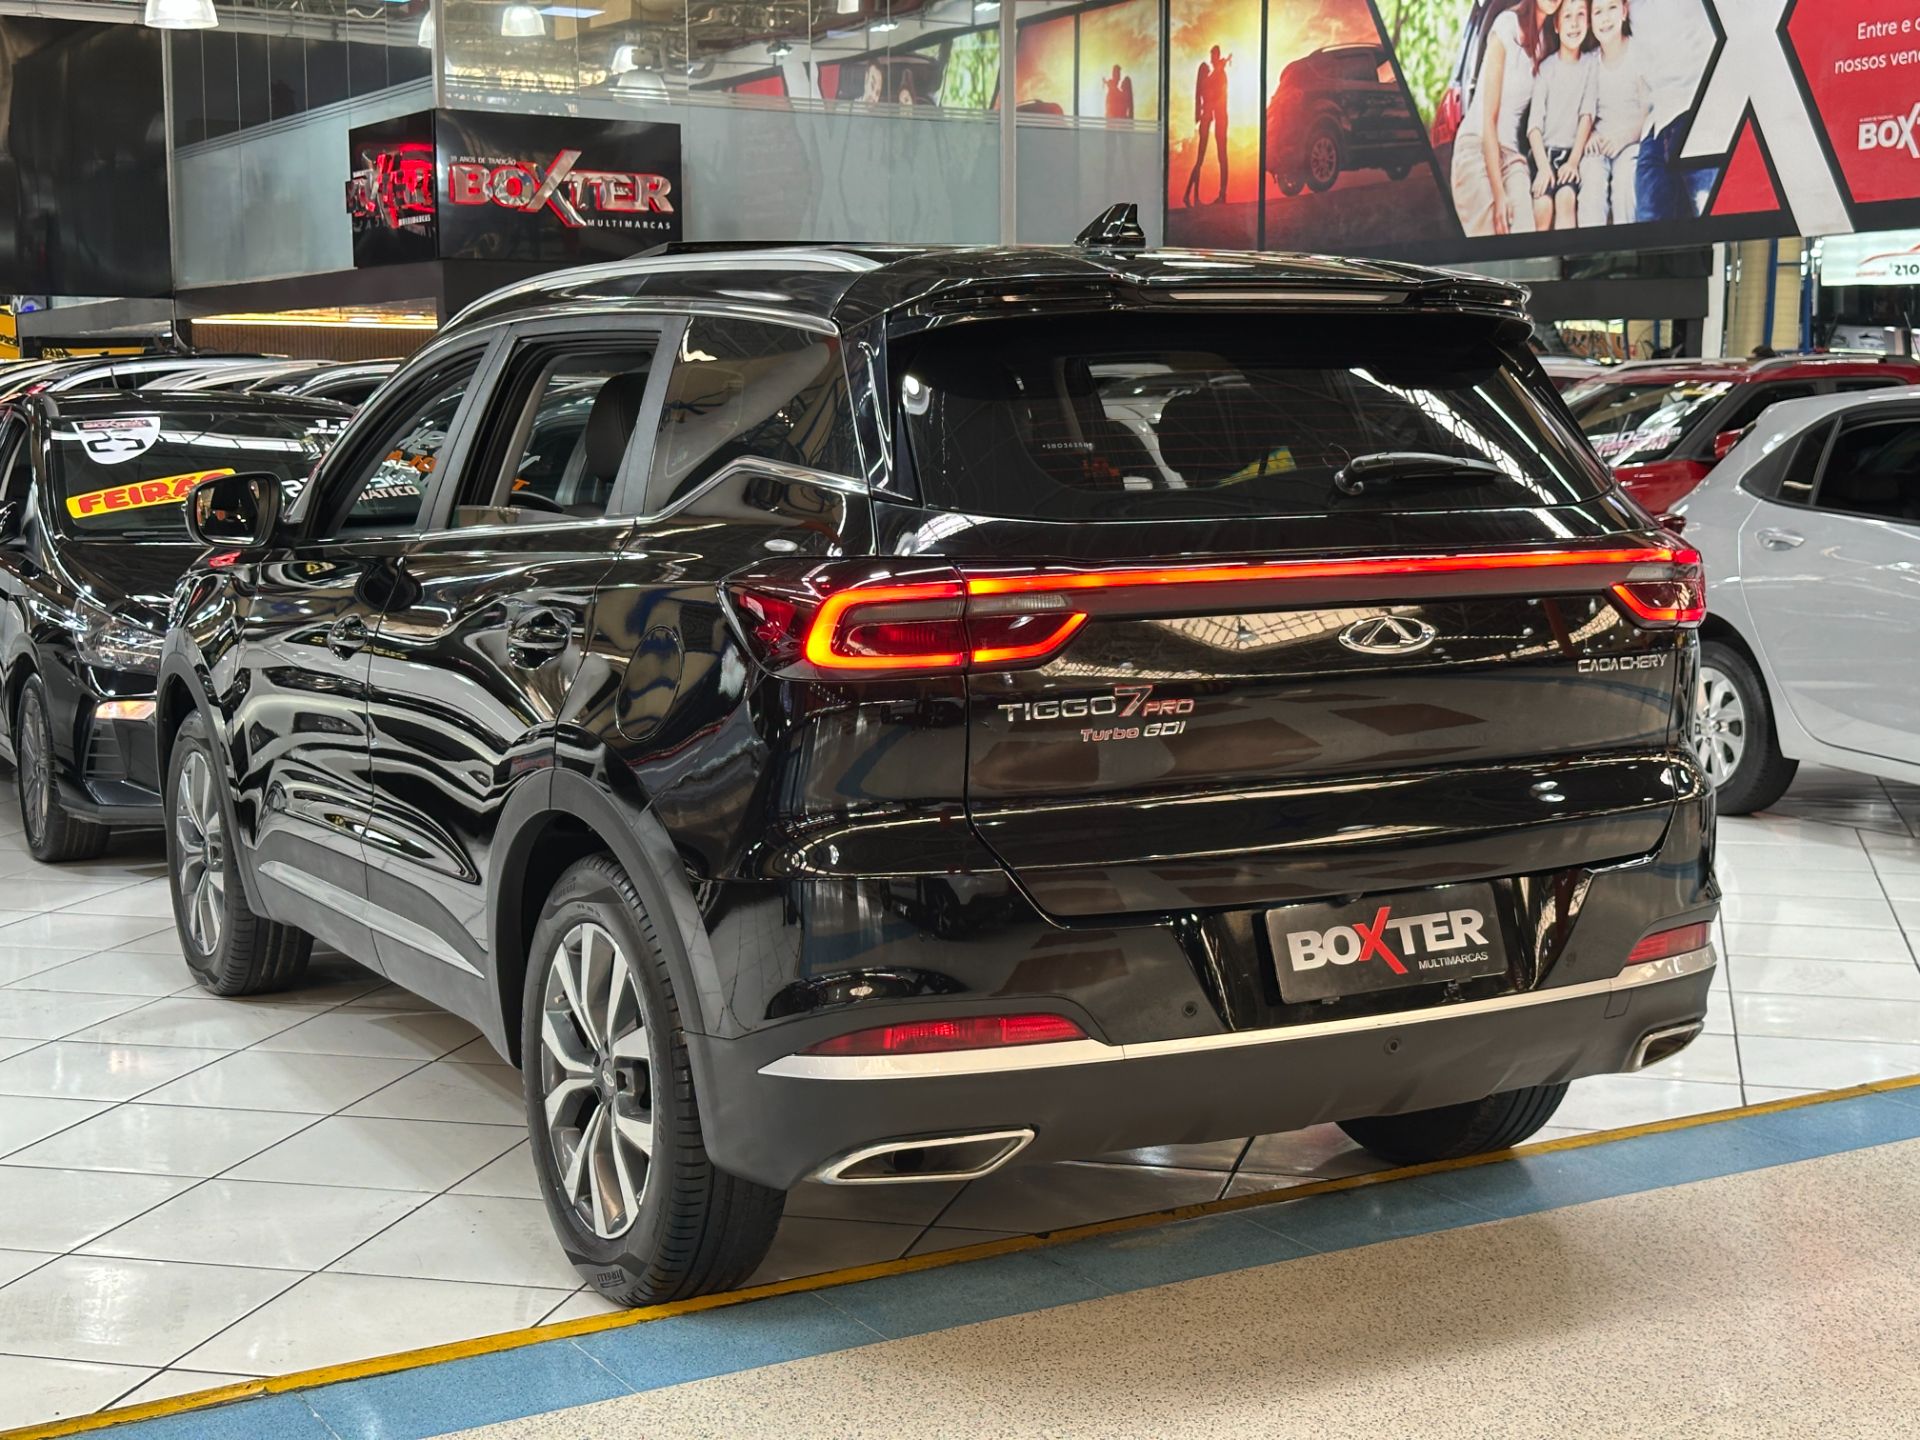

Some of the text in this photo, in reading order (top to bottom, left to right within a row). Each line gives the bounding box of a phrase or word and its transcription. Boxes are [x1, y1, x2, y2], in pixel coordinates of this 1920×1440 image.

[1857, 21, 1898, 40] Entre
[1901, 19, 1911, 32] e
[1834, 54, 1887, 74] nossos
[1858, 101, 1920, 159] BOX
[449, 149, 674, 228] BOXTER
[587, 218, 672, 231] MULTIMARCAS
[78, 473, 226, 514] FEIRÃ
[1620, 654, 1667, 670] CHERY
[998, 696, 1117, 722] TIGGO
[1142, 699, 1195, 717] PRO
[1081, 721, 1186, 742] Turbo GDI
[1287, 906, 1489, 975] BOXTER
[1418, 951, 1489, 970] MULTIMARCAS
